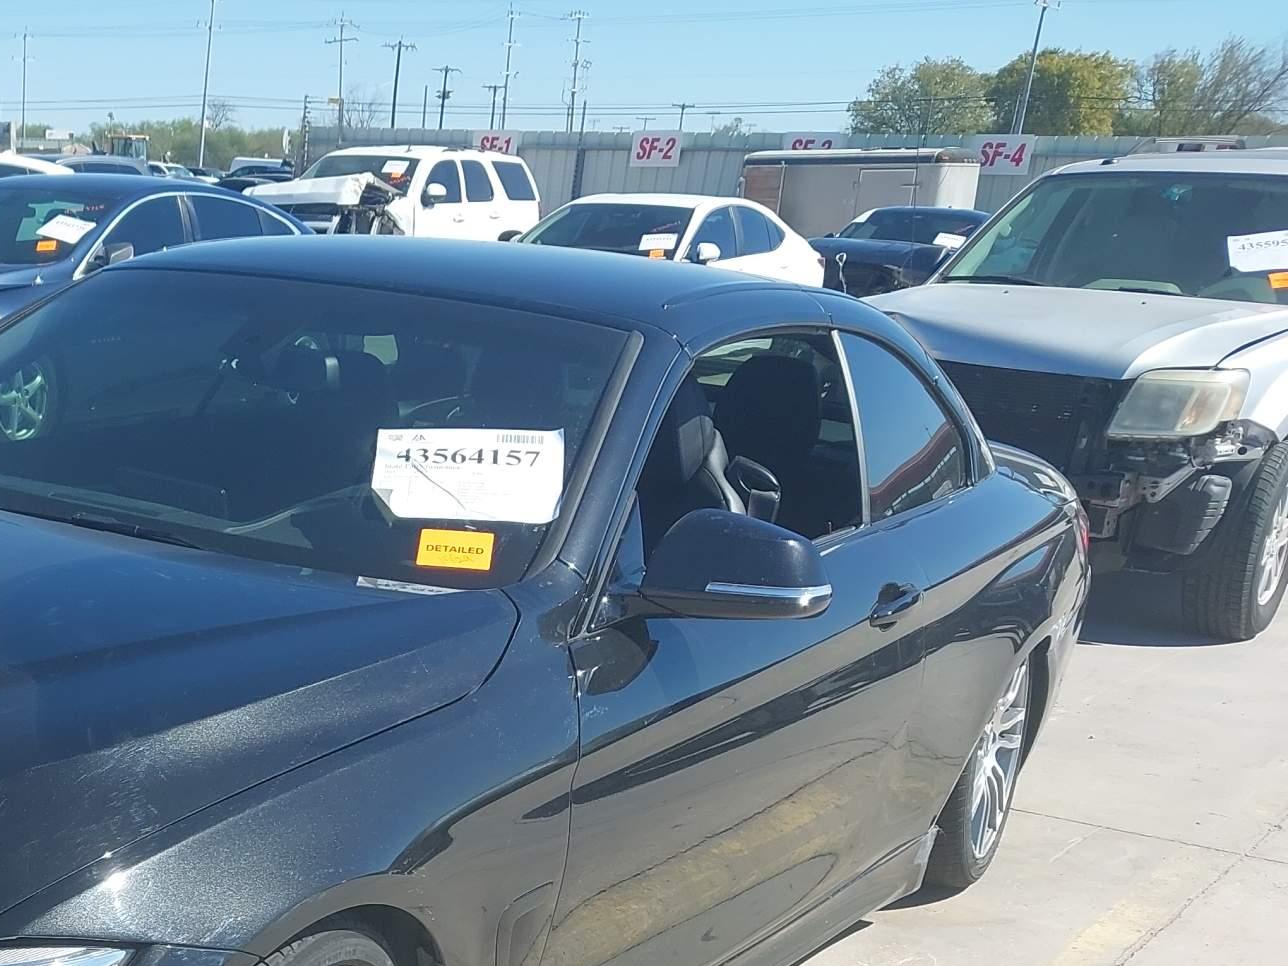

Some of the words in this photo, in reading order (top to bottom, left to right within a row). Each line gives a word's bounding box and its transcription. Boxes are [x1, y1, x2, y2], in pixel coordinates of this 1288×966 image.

[479, 136, 512, 154] SF-1
[636, 137, 677, 160] SF-2
[980, 142, 1027, 167] SF-4
[396, 447, 541, 468] 43564157
[425, 544, 485, 555] DETAILED
